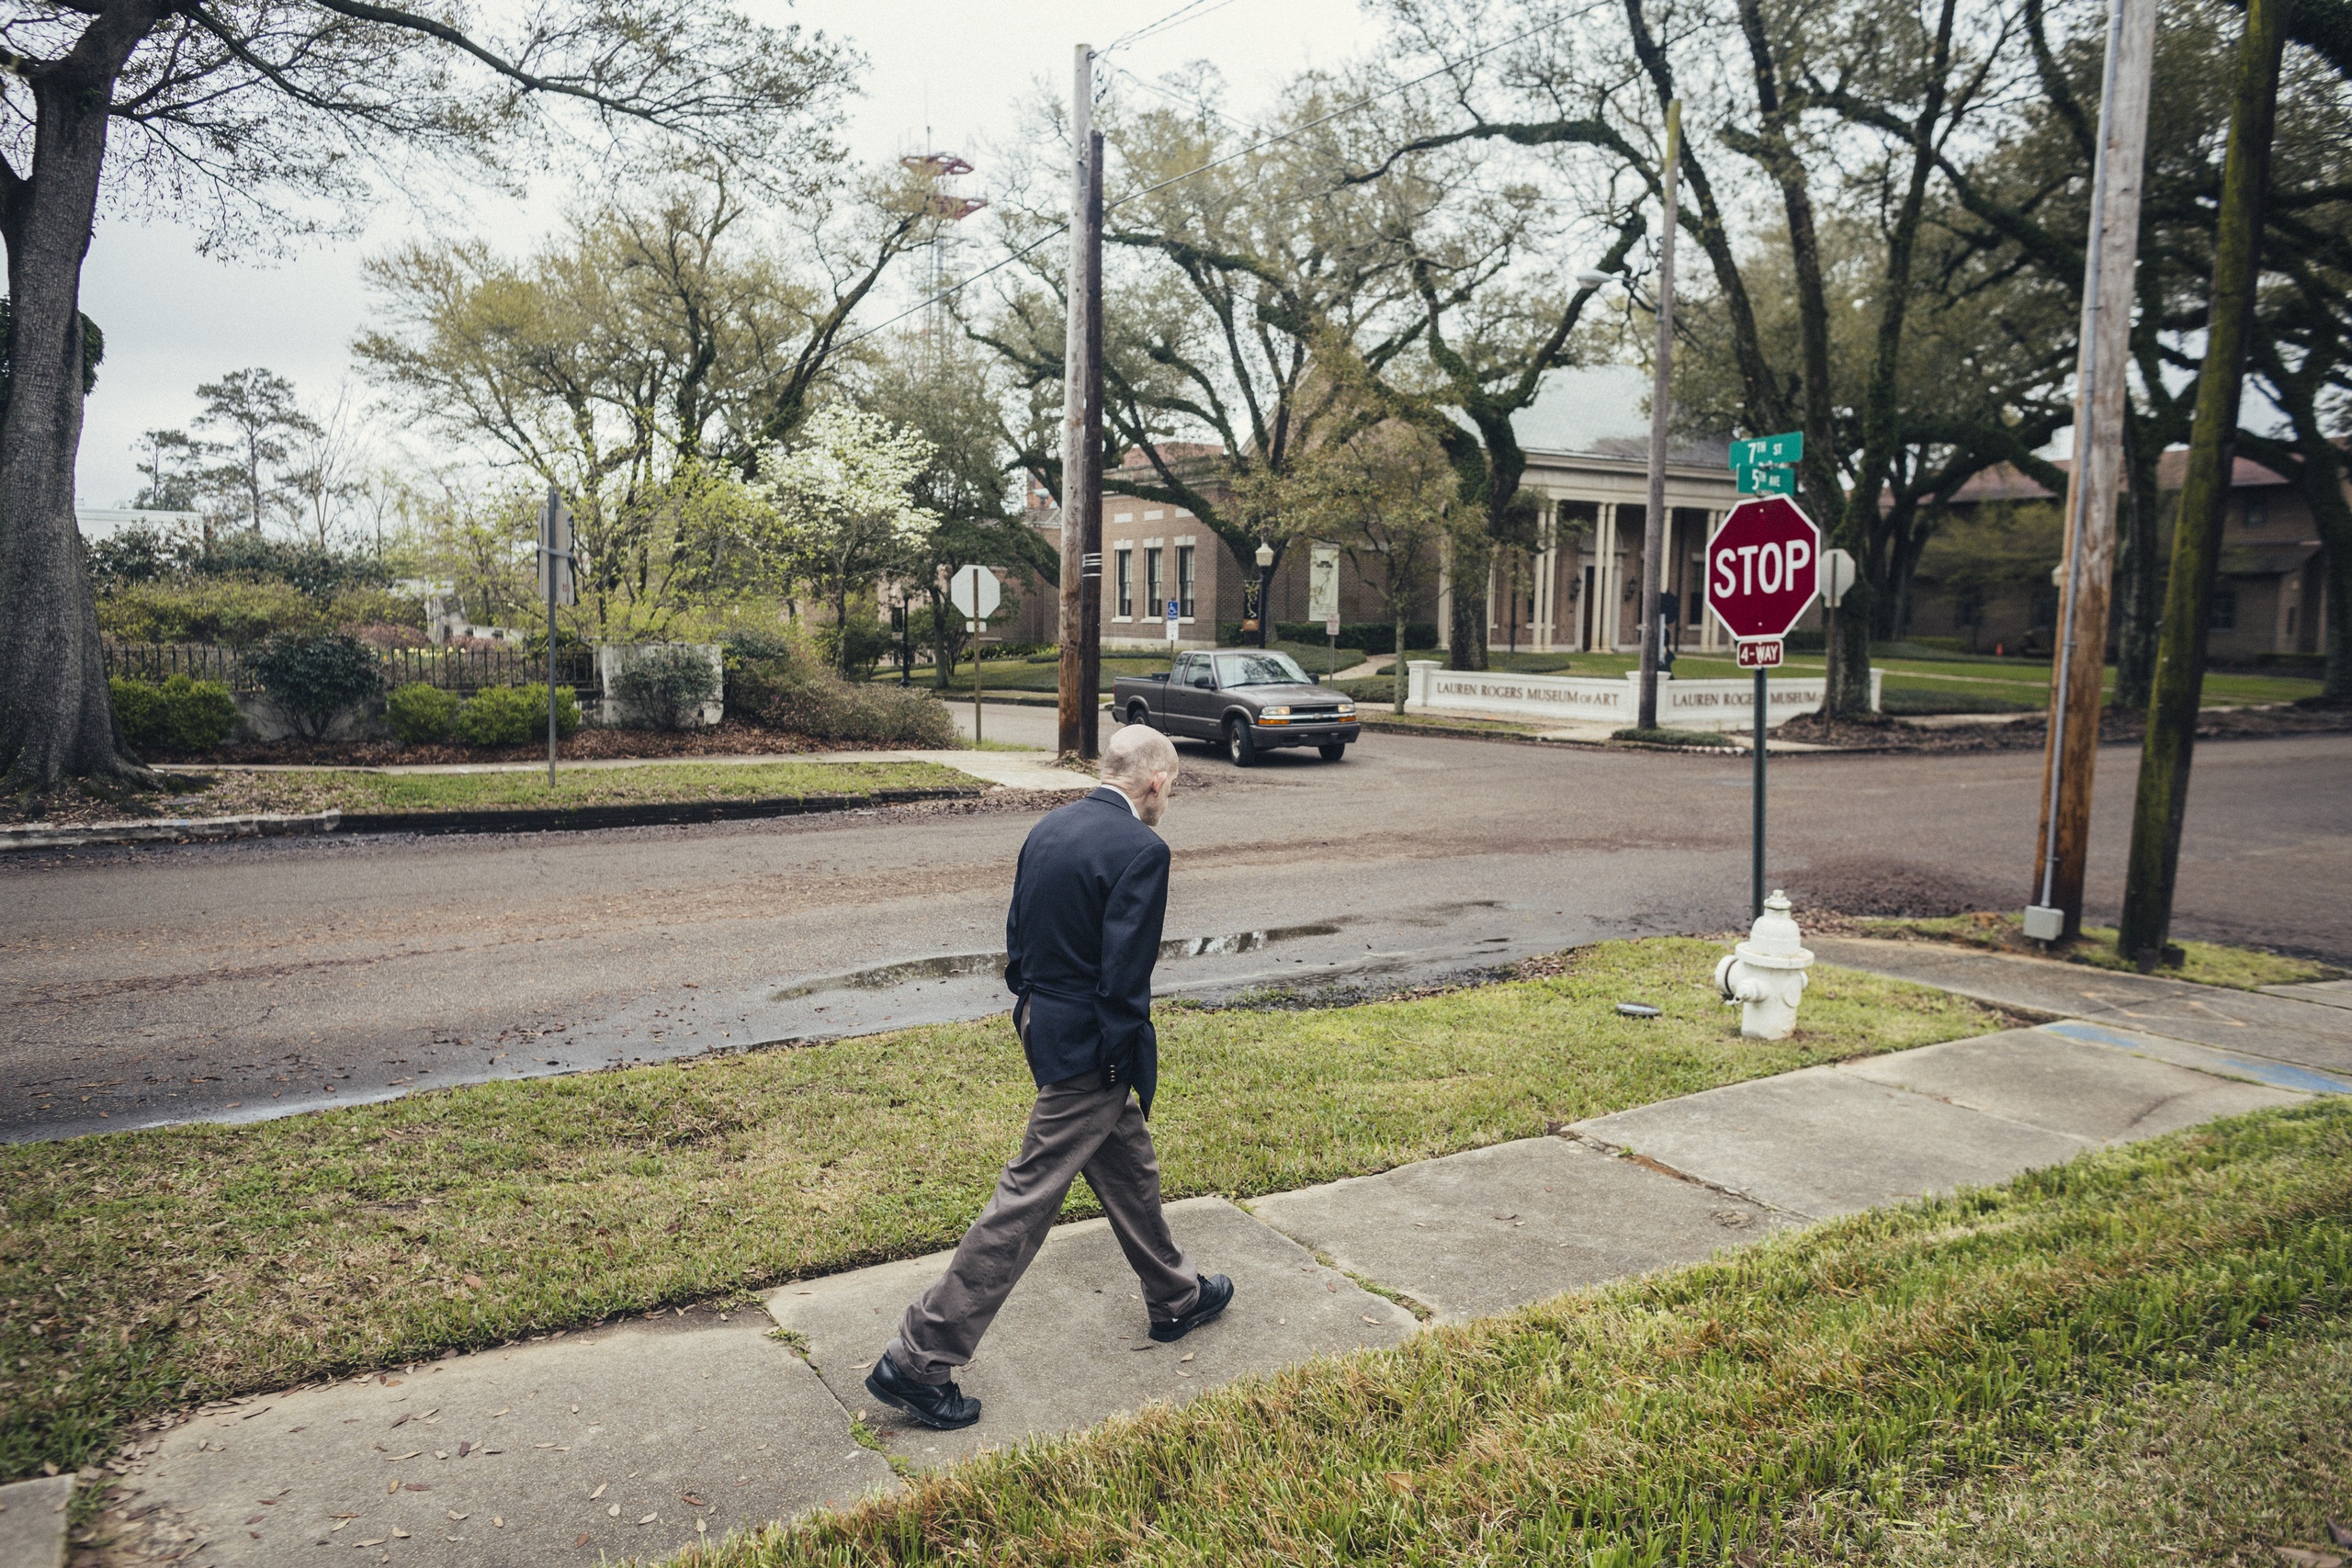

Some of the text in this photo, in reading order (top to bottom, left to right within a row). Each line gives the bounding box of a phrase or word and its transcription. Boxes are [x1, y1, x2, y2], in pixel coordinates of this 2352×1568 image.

[1747, 442, 1782, 465] 7TH ST
[1751, 468, 1781, 491] 5TH AVE
[1713, 539, 1811, 599] STOP
[1740, 645, 1779, 663] 4-WAY
[1437, 682, 1477, 696] LAUREN
[1480, 685, 1523, 699] ROGERS
[1527, 688, 1578, 704] MUSEUM
[1593, 693, 1620, 706] ART
[1672, 693, 1719, 707] LAUREN
[1724, 692, 1754, 706] ROGE
[1770, 690, 1816, 705] MUSEUM
